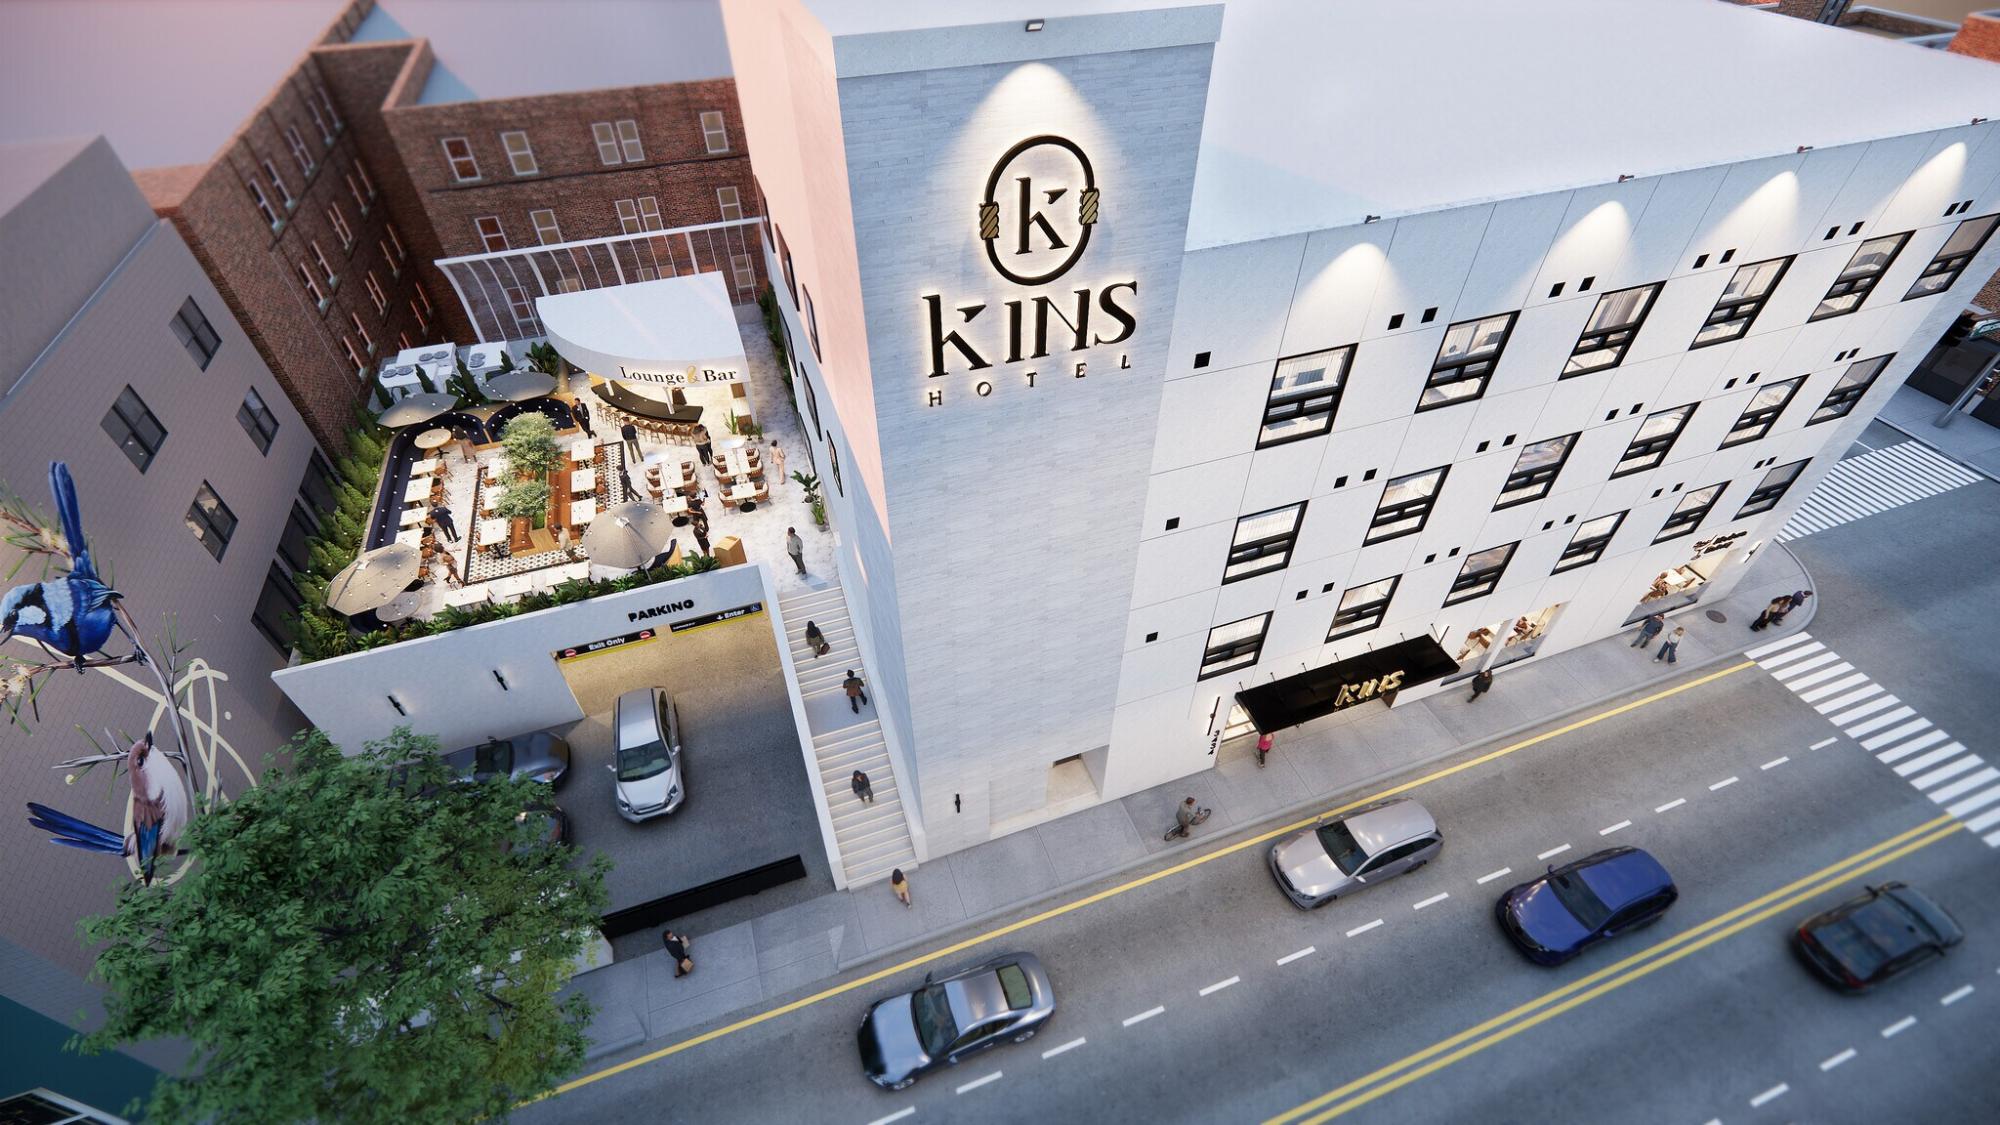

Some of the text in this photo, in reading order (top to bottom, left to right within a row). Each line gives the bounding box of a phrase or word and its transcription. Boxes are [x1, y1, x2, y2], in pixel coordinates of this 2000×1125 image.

[619, 365, 737, 386] Lounge & Bar
[928, 354, 1131, 407] HOTEL
[724, 609, 745, 619] Enter
[606, 637, 625, 646] Only
